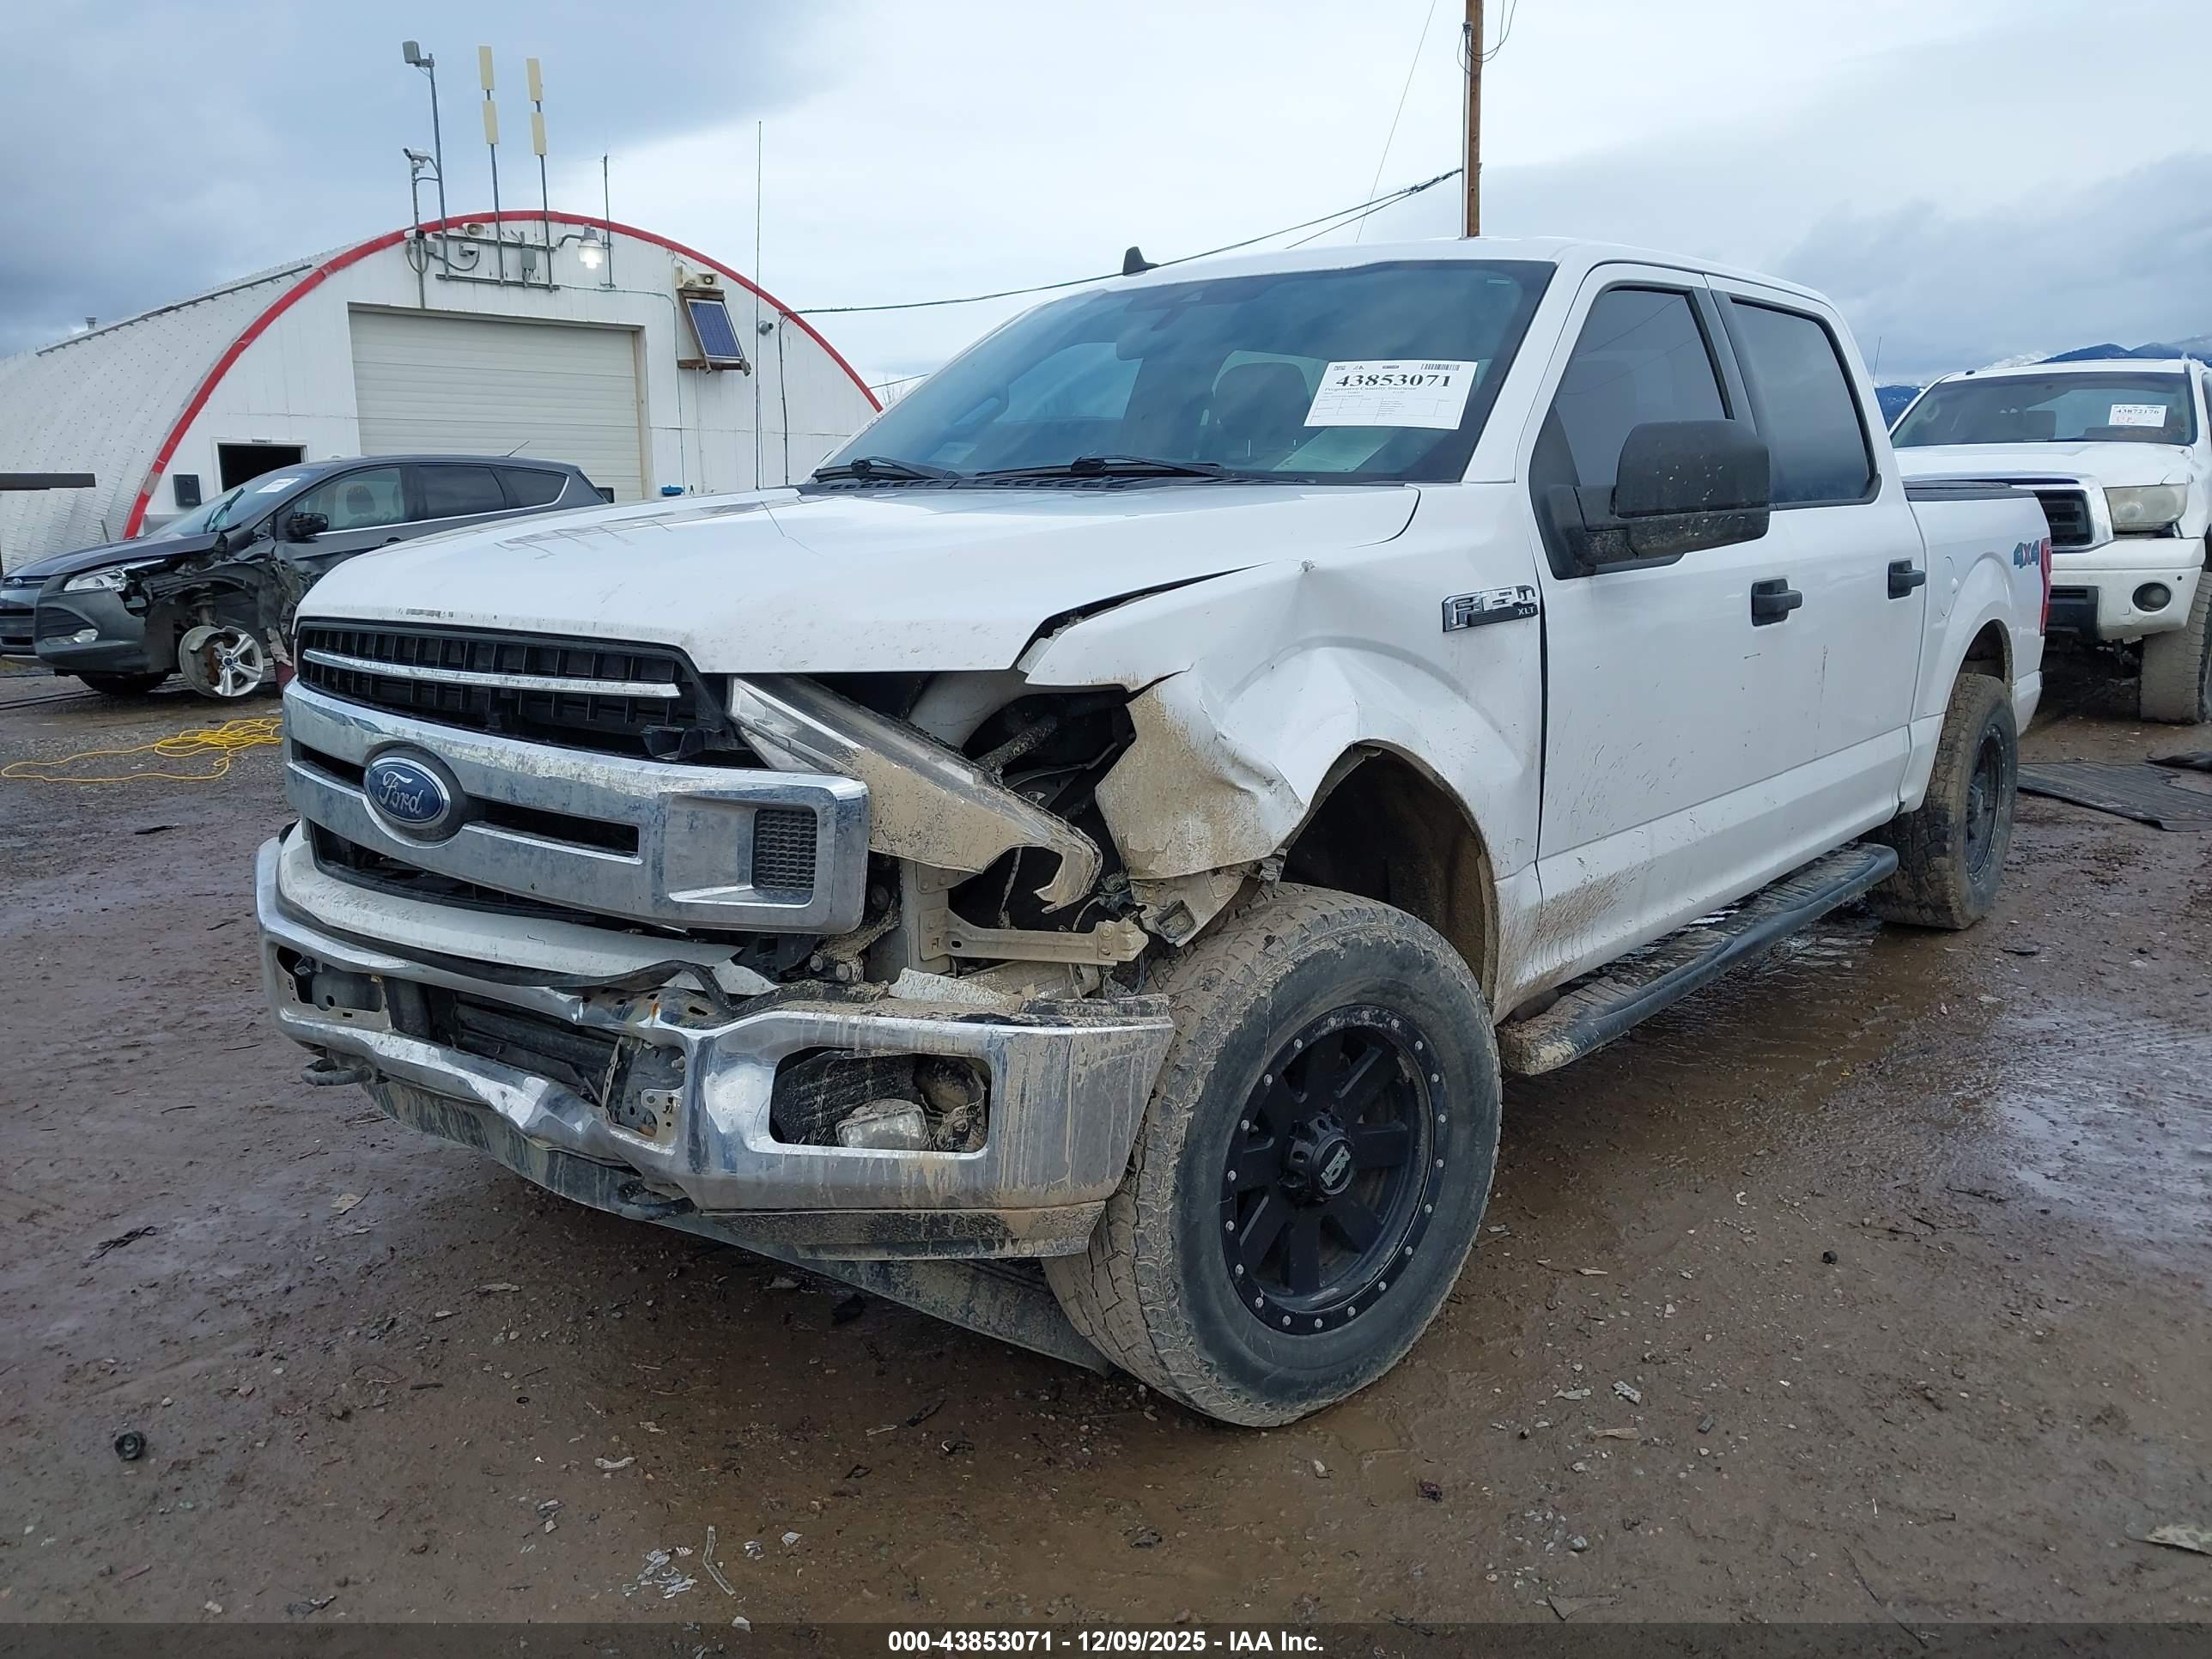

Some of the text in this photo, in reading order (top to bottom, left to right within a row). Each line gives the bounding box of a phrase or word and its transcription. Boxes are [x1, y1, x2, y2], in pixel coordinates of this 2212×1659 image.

[1335, 374, 1452, 387] 43853071
[1517, 605, 1535, 616] XLT
[379, 770, 424, 814] Ford
